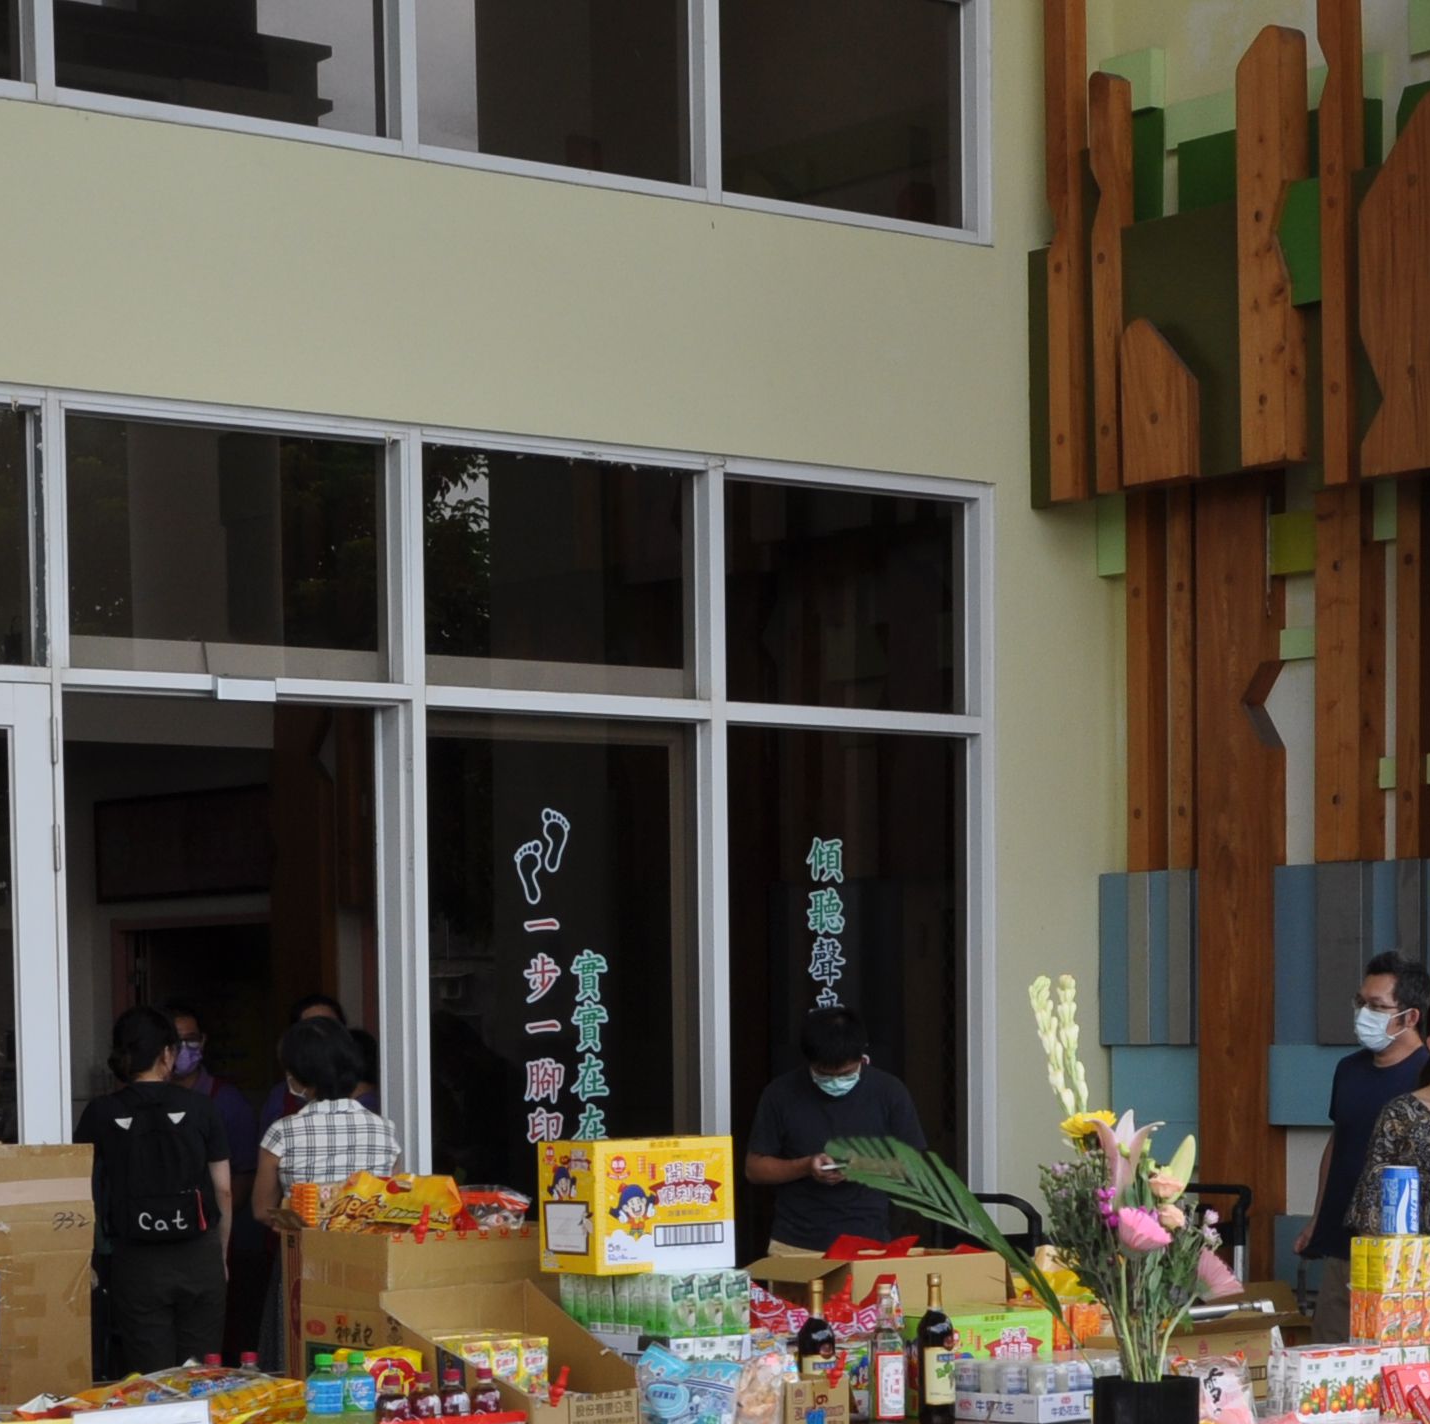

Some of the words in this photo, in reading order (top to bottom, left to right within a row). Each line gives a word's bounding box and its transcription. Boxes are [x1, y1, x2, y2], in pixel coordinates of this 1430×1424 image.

[523, 917, 565, 1143] 一步一腳印
[570, 949, 610, 1140] 實實在在
[138, 1210, 189, 1231] Cat
[575, 1401, 633, 1417] 股份有限公司
